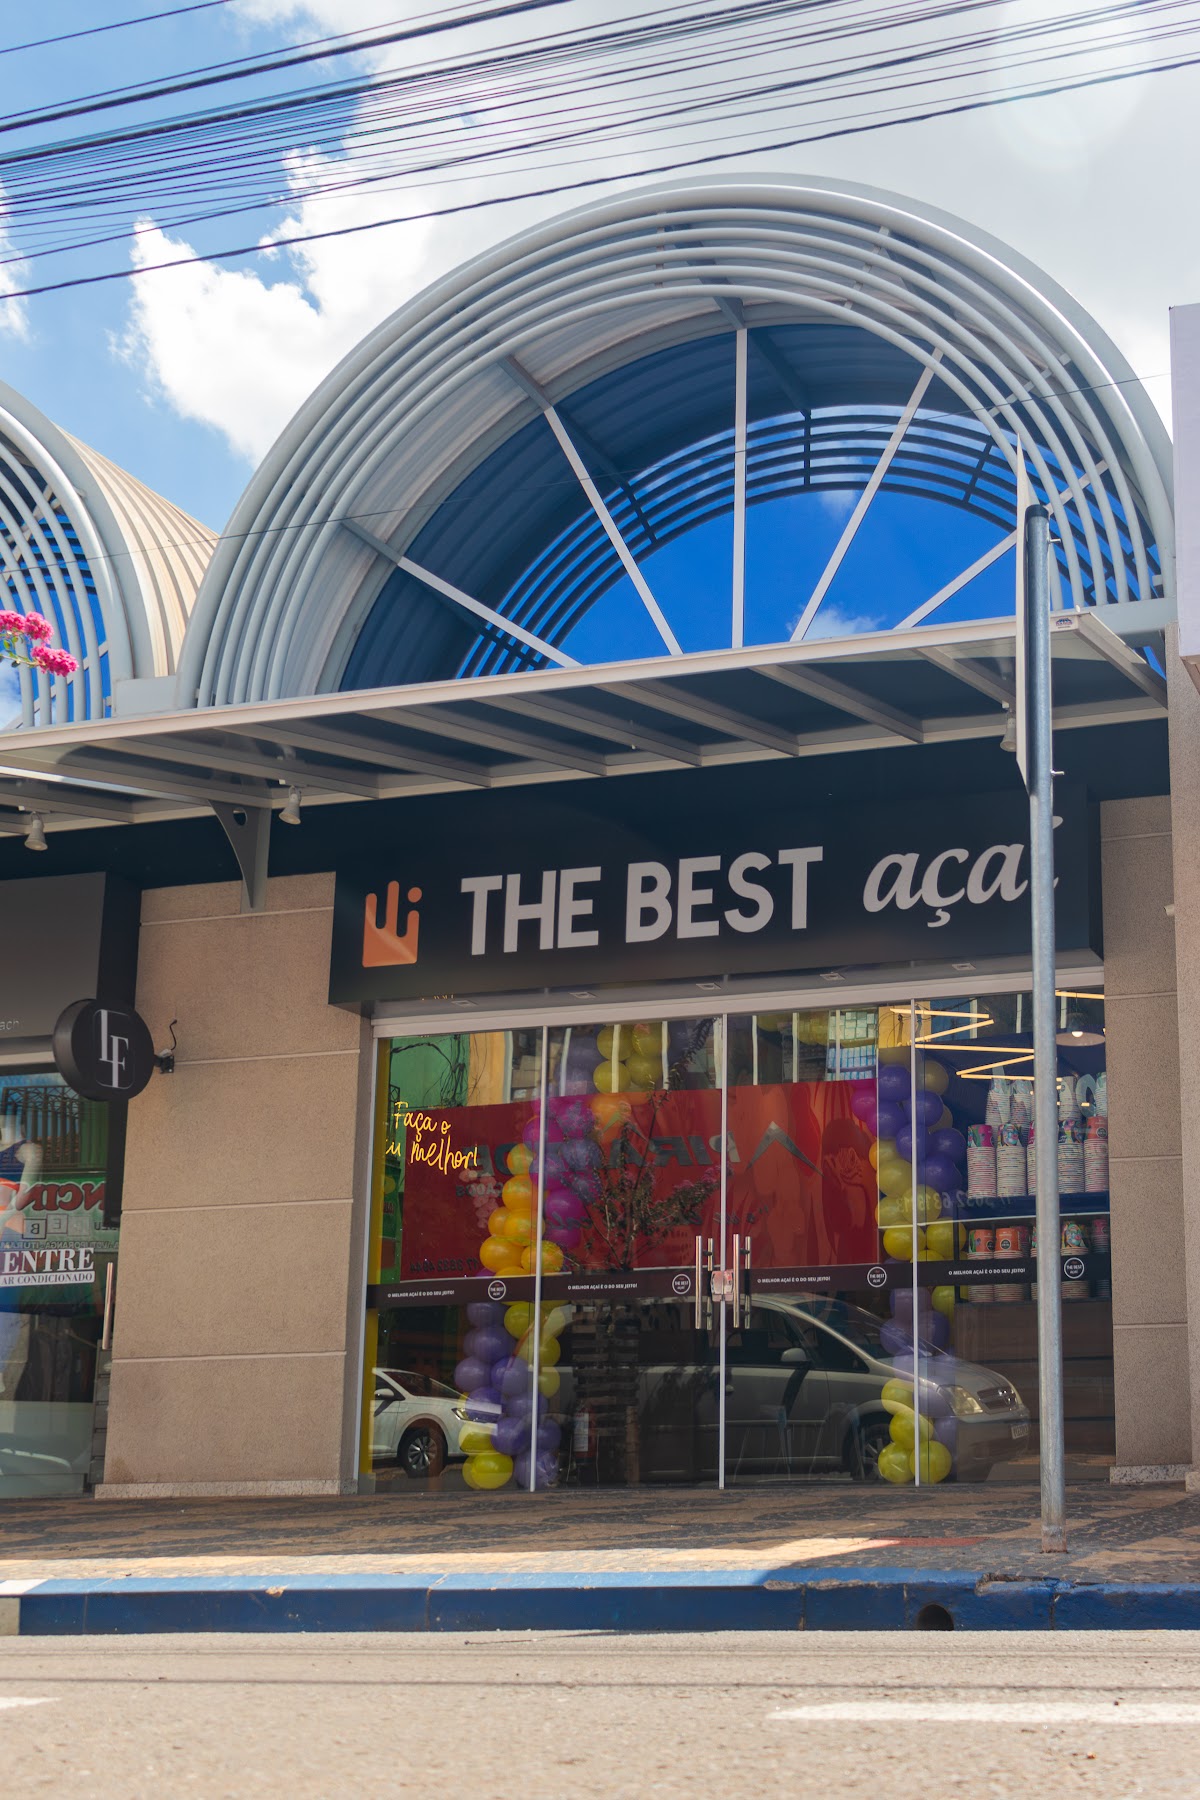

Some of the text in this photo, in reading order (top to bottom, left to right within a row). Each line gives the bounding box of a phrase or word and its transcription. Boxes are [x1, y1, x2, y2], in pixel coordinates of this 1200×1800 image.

[461, 816, 1063, 956] THE BEST aça
[99, 1009, 129, 1088] LF
[393, 1101, 451, 1142] Faça o
[1, 1273, 93, 1285] AR CONDICIONADO
[2, 1248, 95, 1274] ENTRE
